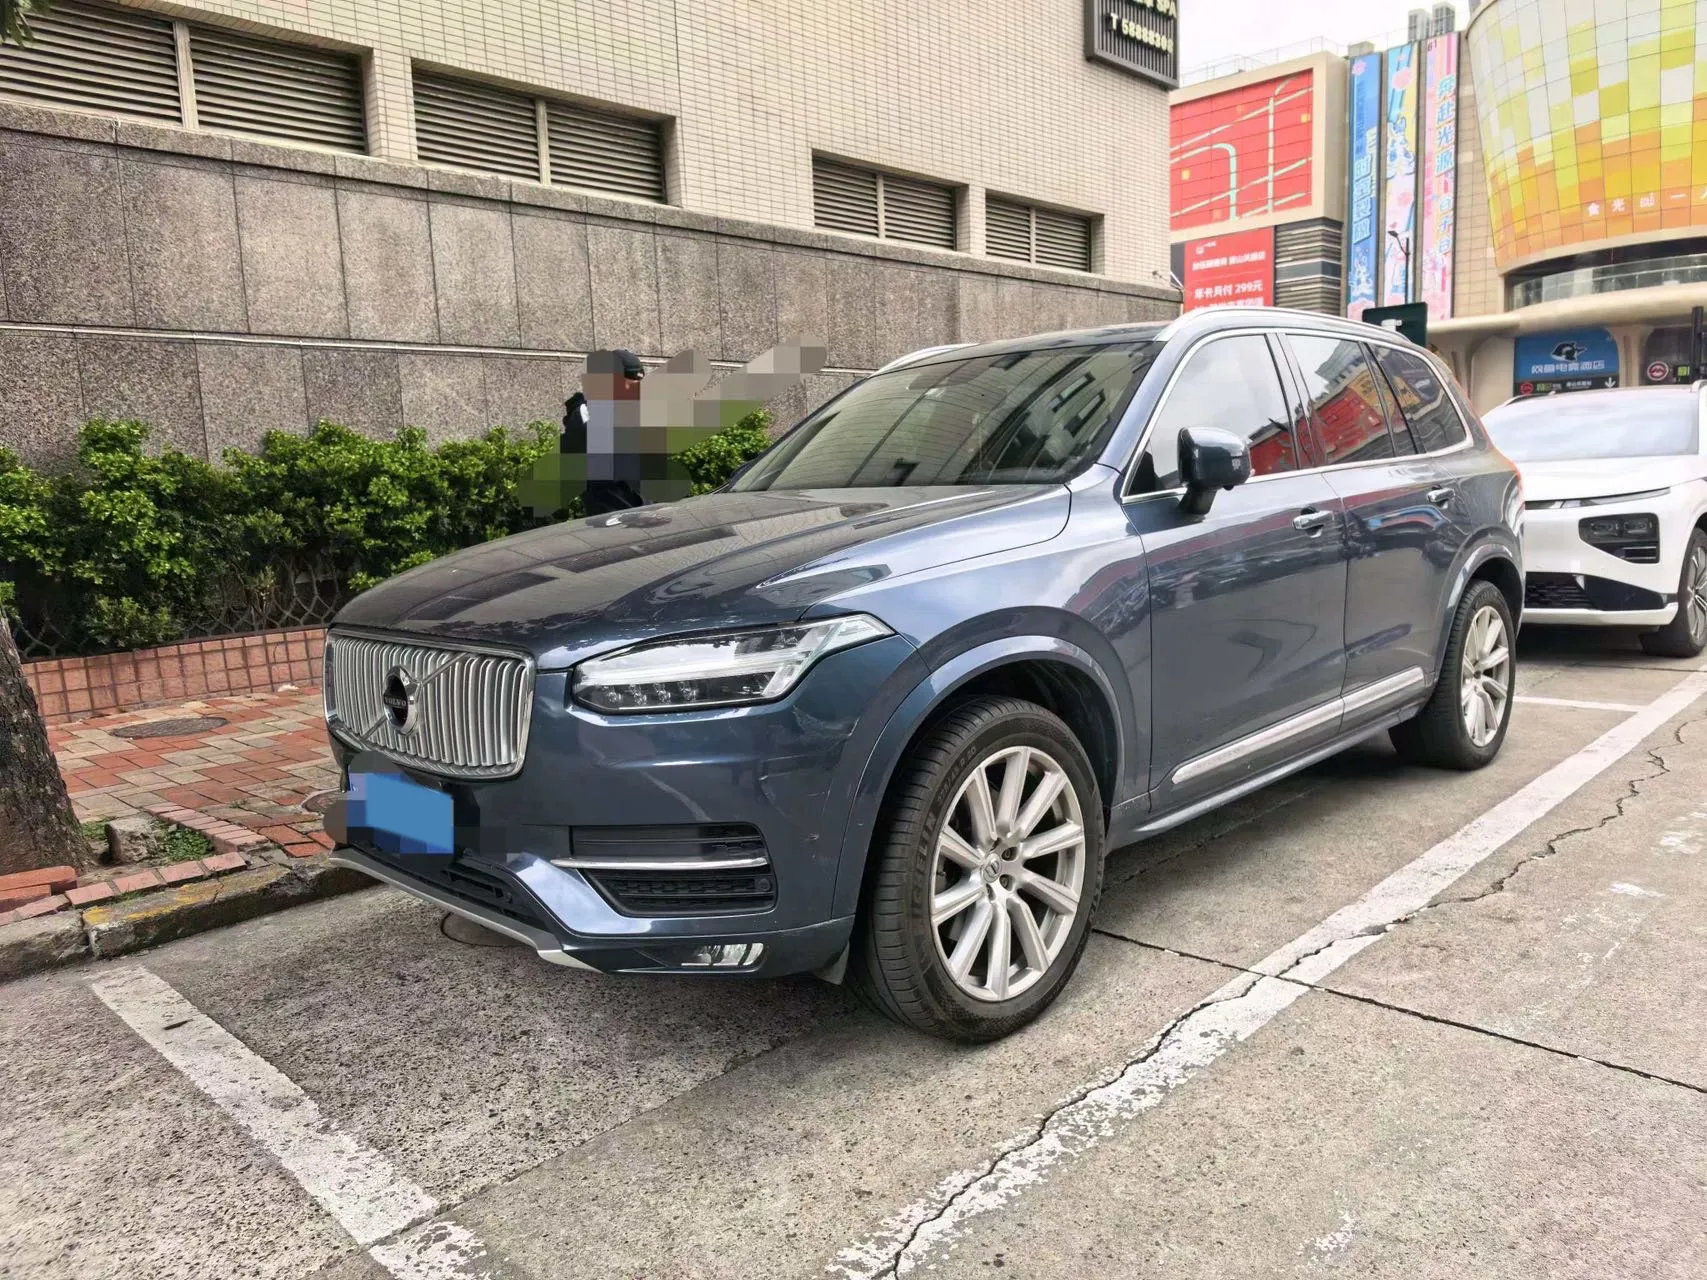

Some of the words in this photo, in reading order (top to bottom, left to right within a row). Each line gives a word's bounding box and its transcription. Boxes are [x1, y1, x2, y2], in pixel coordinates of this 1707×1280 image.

[1111, 12, 1118, 31] T
[1194, 285, 1233, 300] 年卡月付
[1235, 280, 1264, 294] 299元
[384, 696, 407, 707] VOLVO
